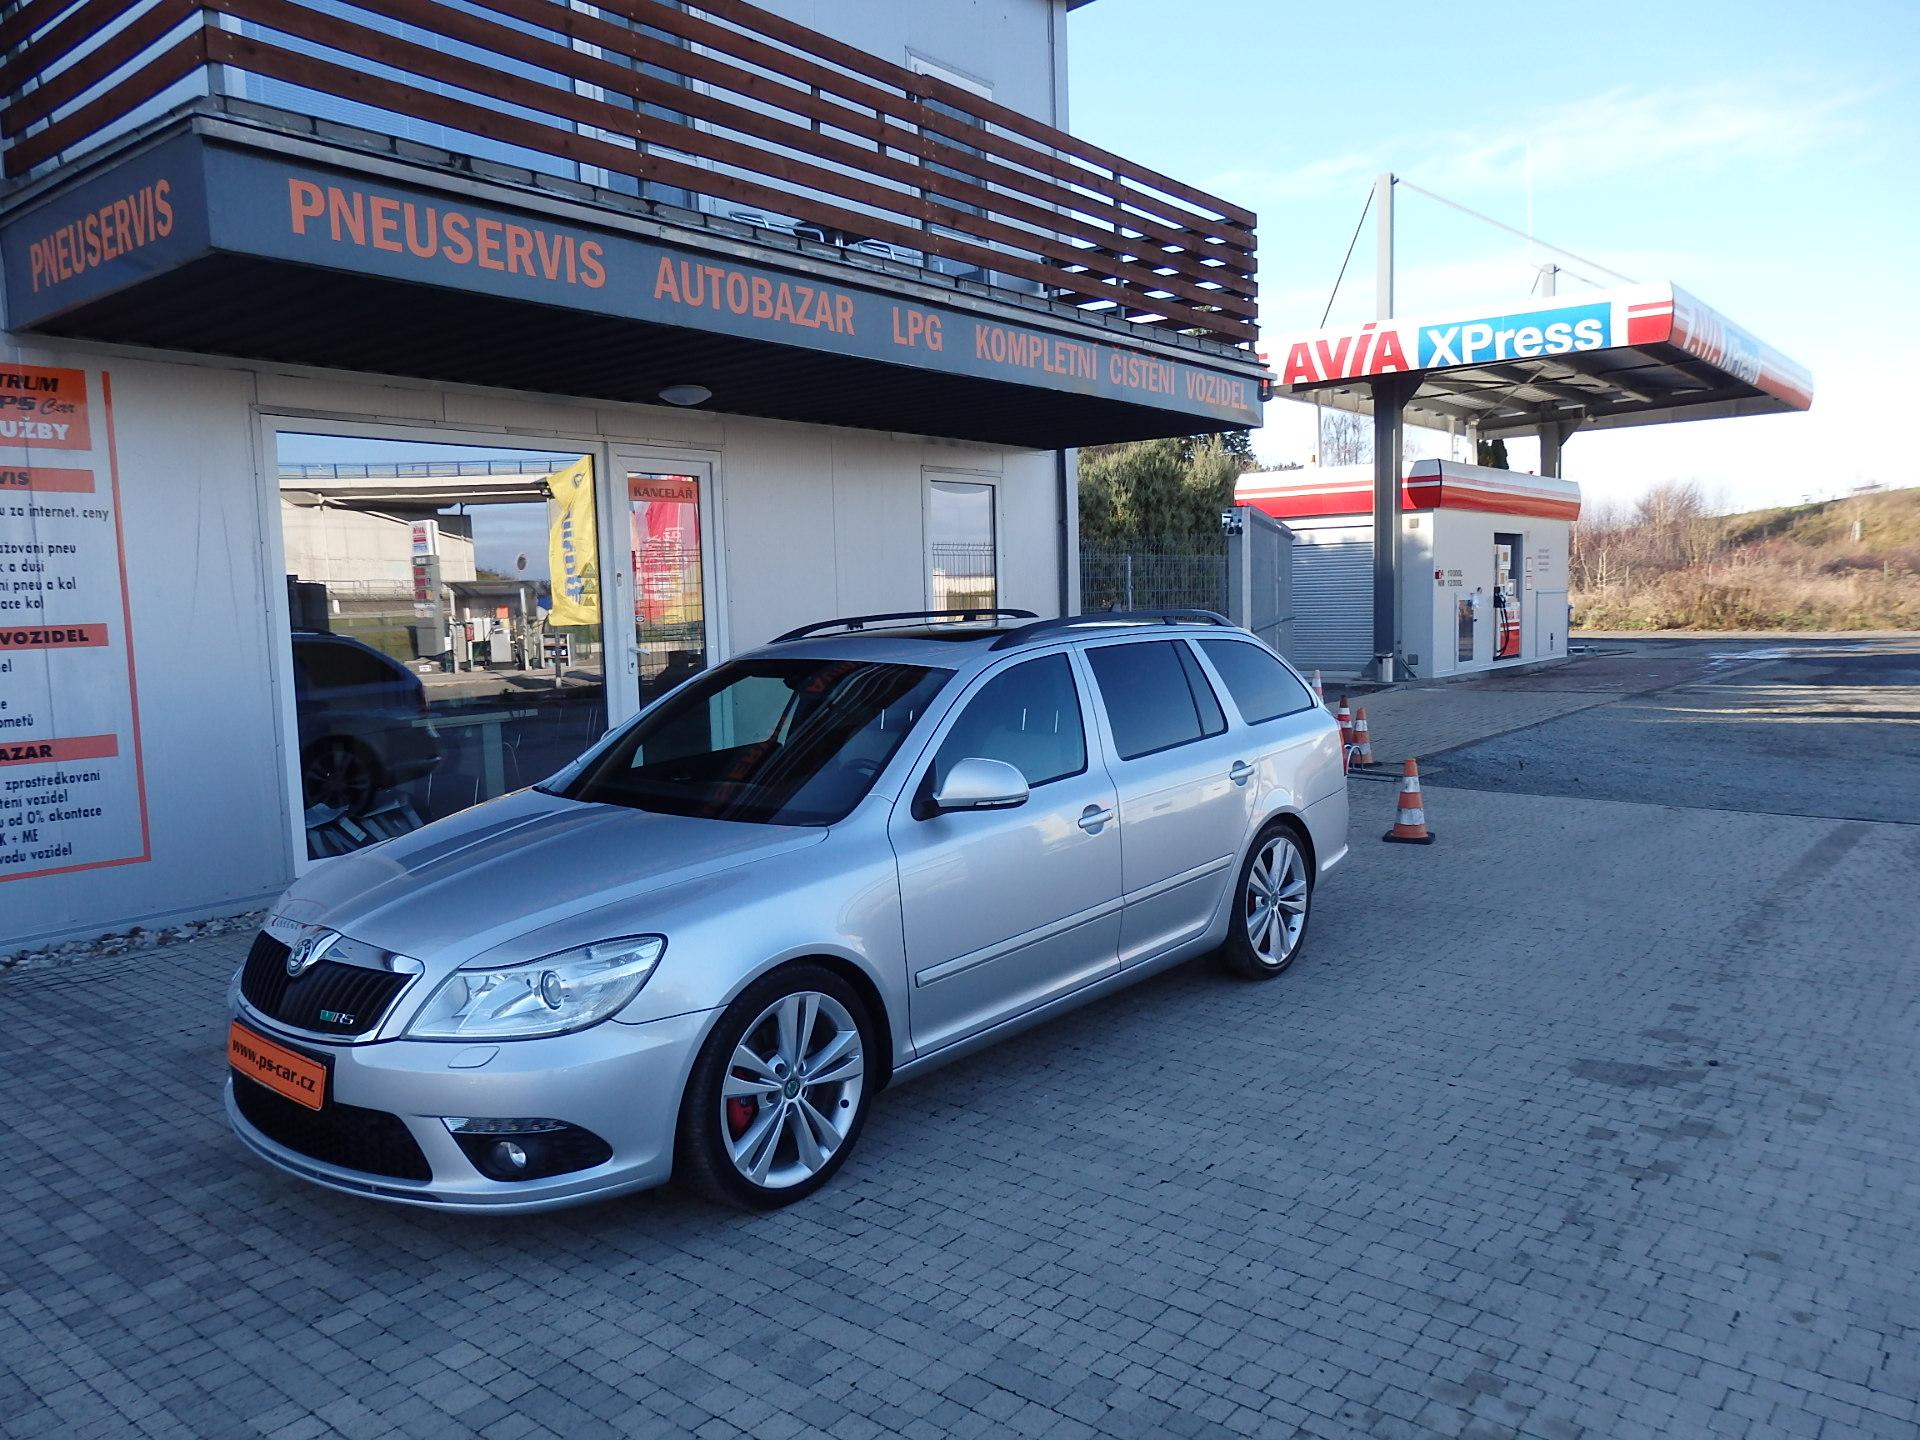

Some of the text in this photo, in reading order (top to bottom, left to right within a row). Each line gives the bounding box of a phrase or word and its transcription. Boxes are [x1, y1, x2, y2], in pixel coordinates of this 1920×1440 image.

[30, 178, 174, 293] PNEUSERVIS
[288, 178, 1248, 410] PNEUSERVIS AUTOBAZAR LPG KOMPLETNÍ ČIŠTĚNÍ VOZIDEL
[1283, 314, 1604, 386] AVIA XPress
[10, 507, 24, 517] za
[29, 503, 79, 518] internet.
[82, 508, 109, 522] ceny
[48, 544, 76, 557] pneu
[9, 563, 16, 572] a
[14, 580, 42, 594] pneu
[46, 581, 53, 590] a
[58, 576, 76, 590] kol
[25, 595, 44, 609] kol
[0, 629, 89, 645] VOZIDEL
[27, 789, 68, 806] vozidel
[9, 812, 23, 827] od
[28, 810, 45, 824] 0%
[49, 807, 102, 822] akontace
[31, 842, 72, 859] vozidel
[232, 1038, 316, 1093] www.ps-car.cz
